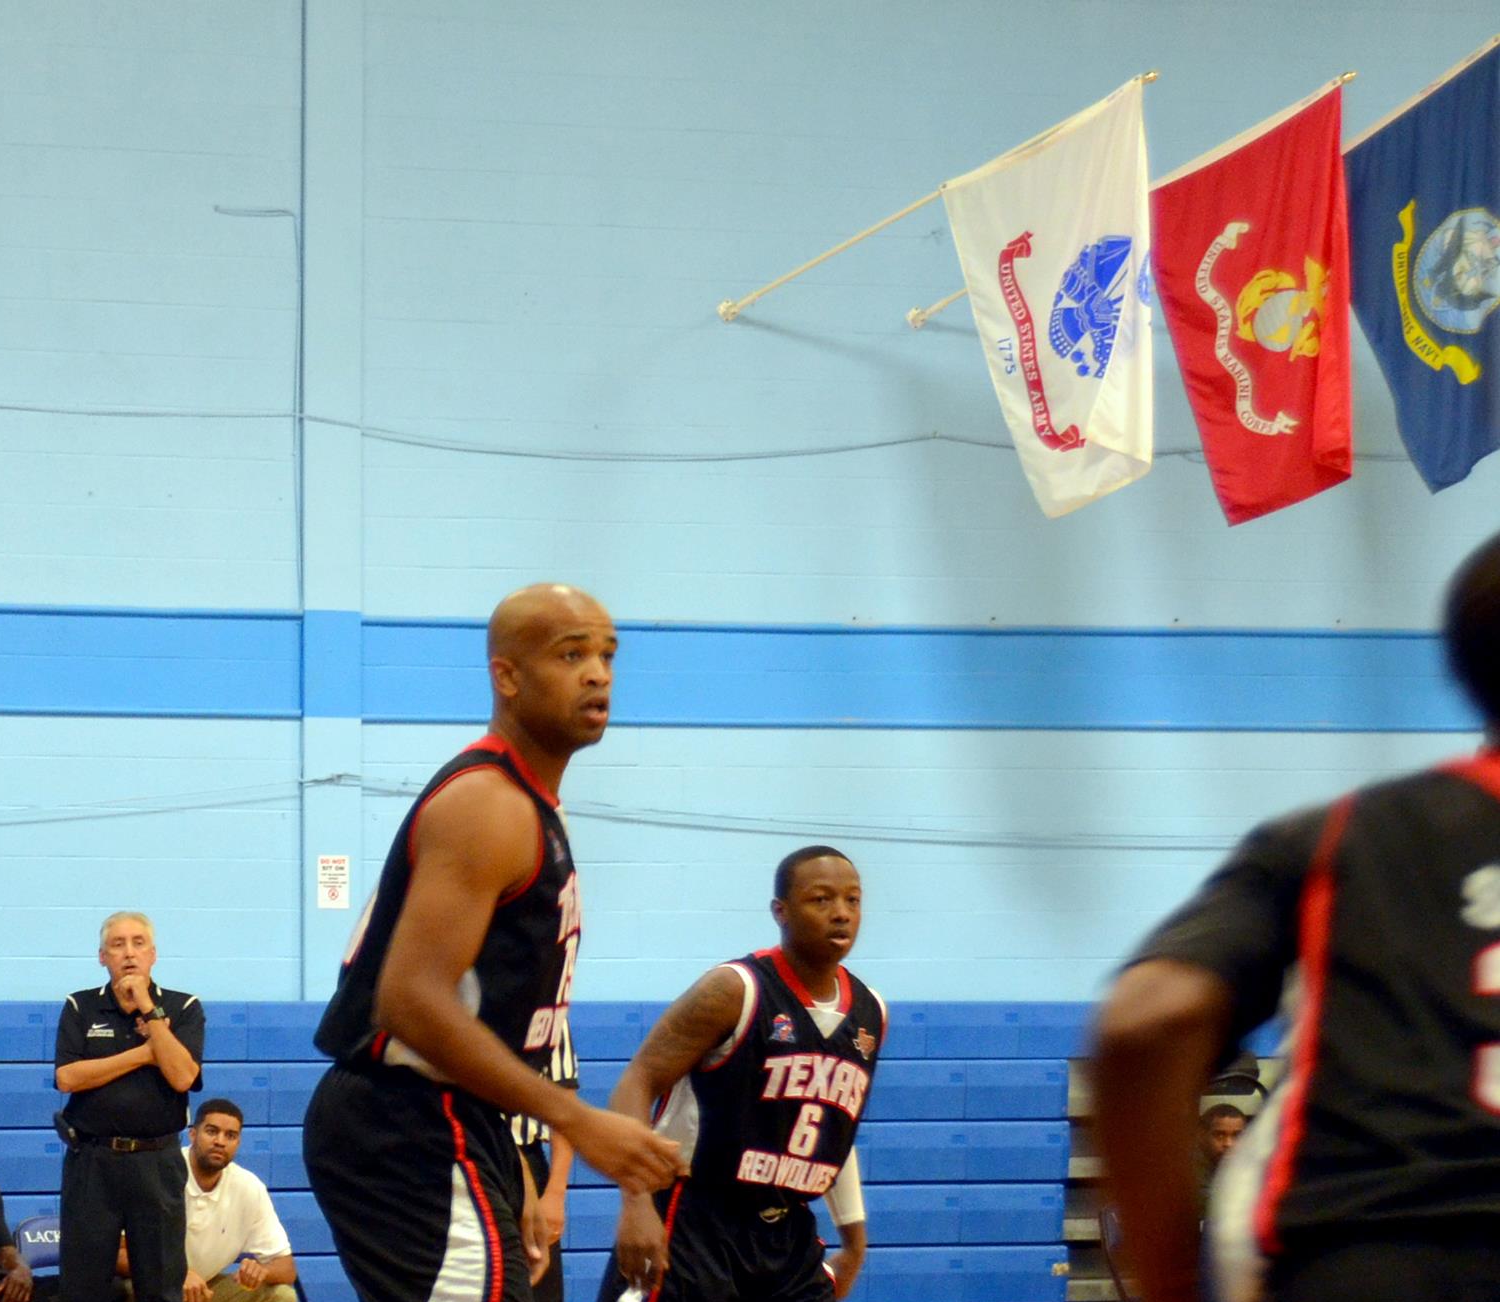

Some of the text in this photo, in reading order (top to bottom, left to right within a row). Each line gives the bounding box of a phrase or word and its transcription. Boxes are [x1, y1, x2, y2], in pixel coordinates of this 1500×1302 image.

[998, 337, 1017, 375] 1775
[1001, 262, 1053, 437] UNITED STATES ARMY
[1198, 240, 1223, 294] UNITED
[1220, 352, 1250, 401] MARINE
[1240, 409, 1275, 434] CORPS
[761, 1054, 869, 1121] TEXAS
[787, 1102, 823, 1158] 6
[736, 1149, 840, 1194] RED WOLVES
